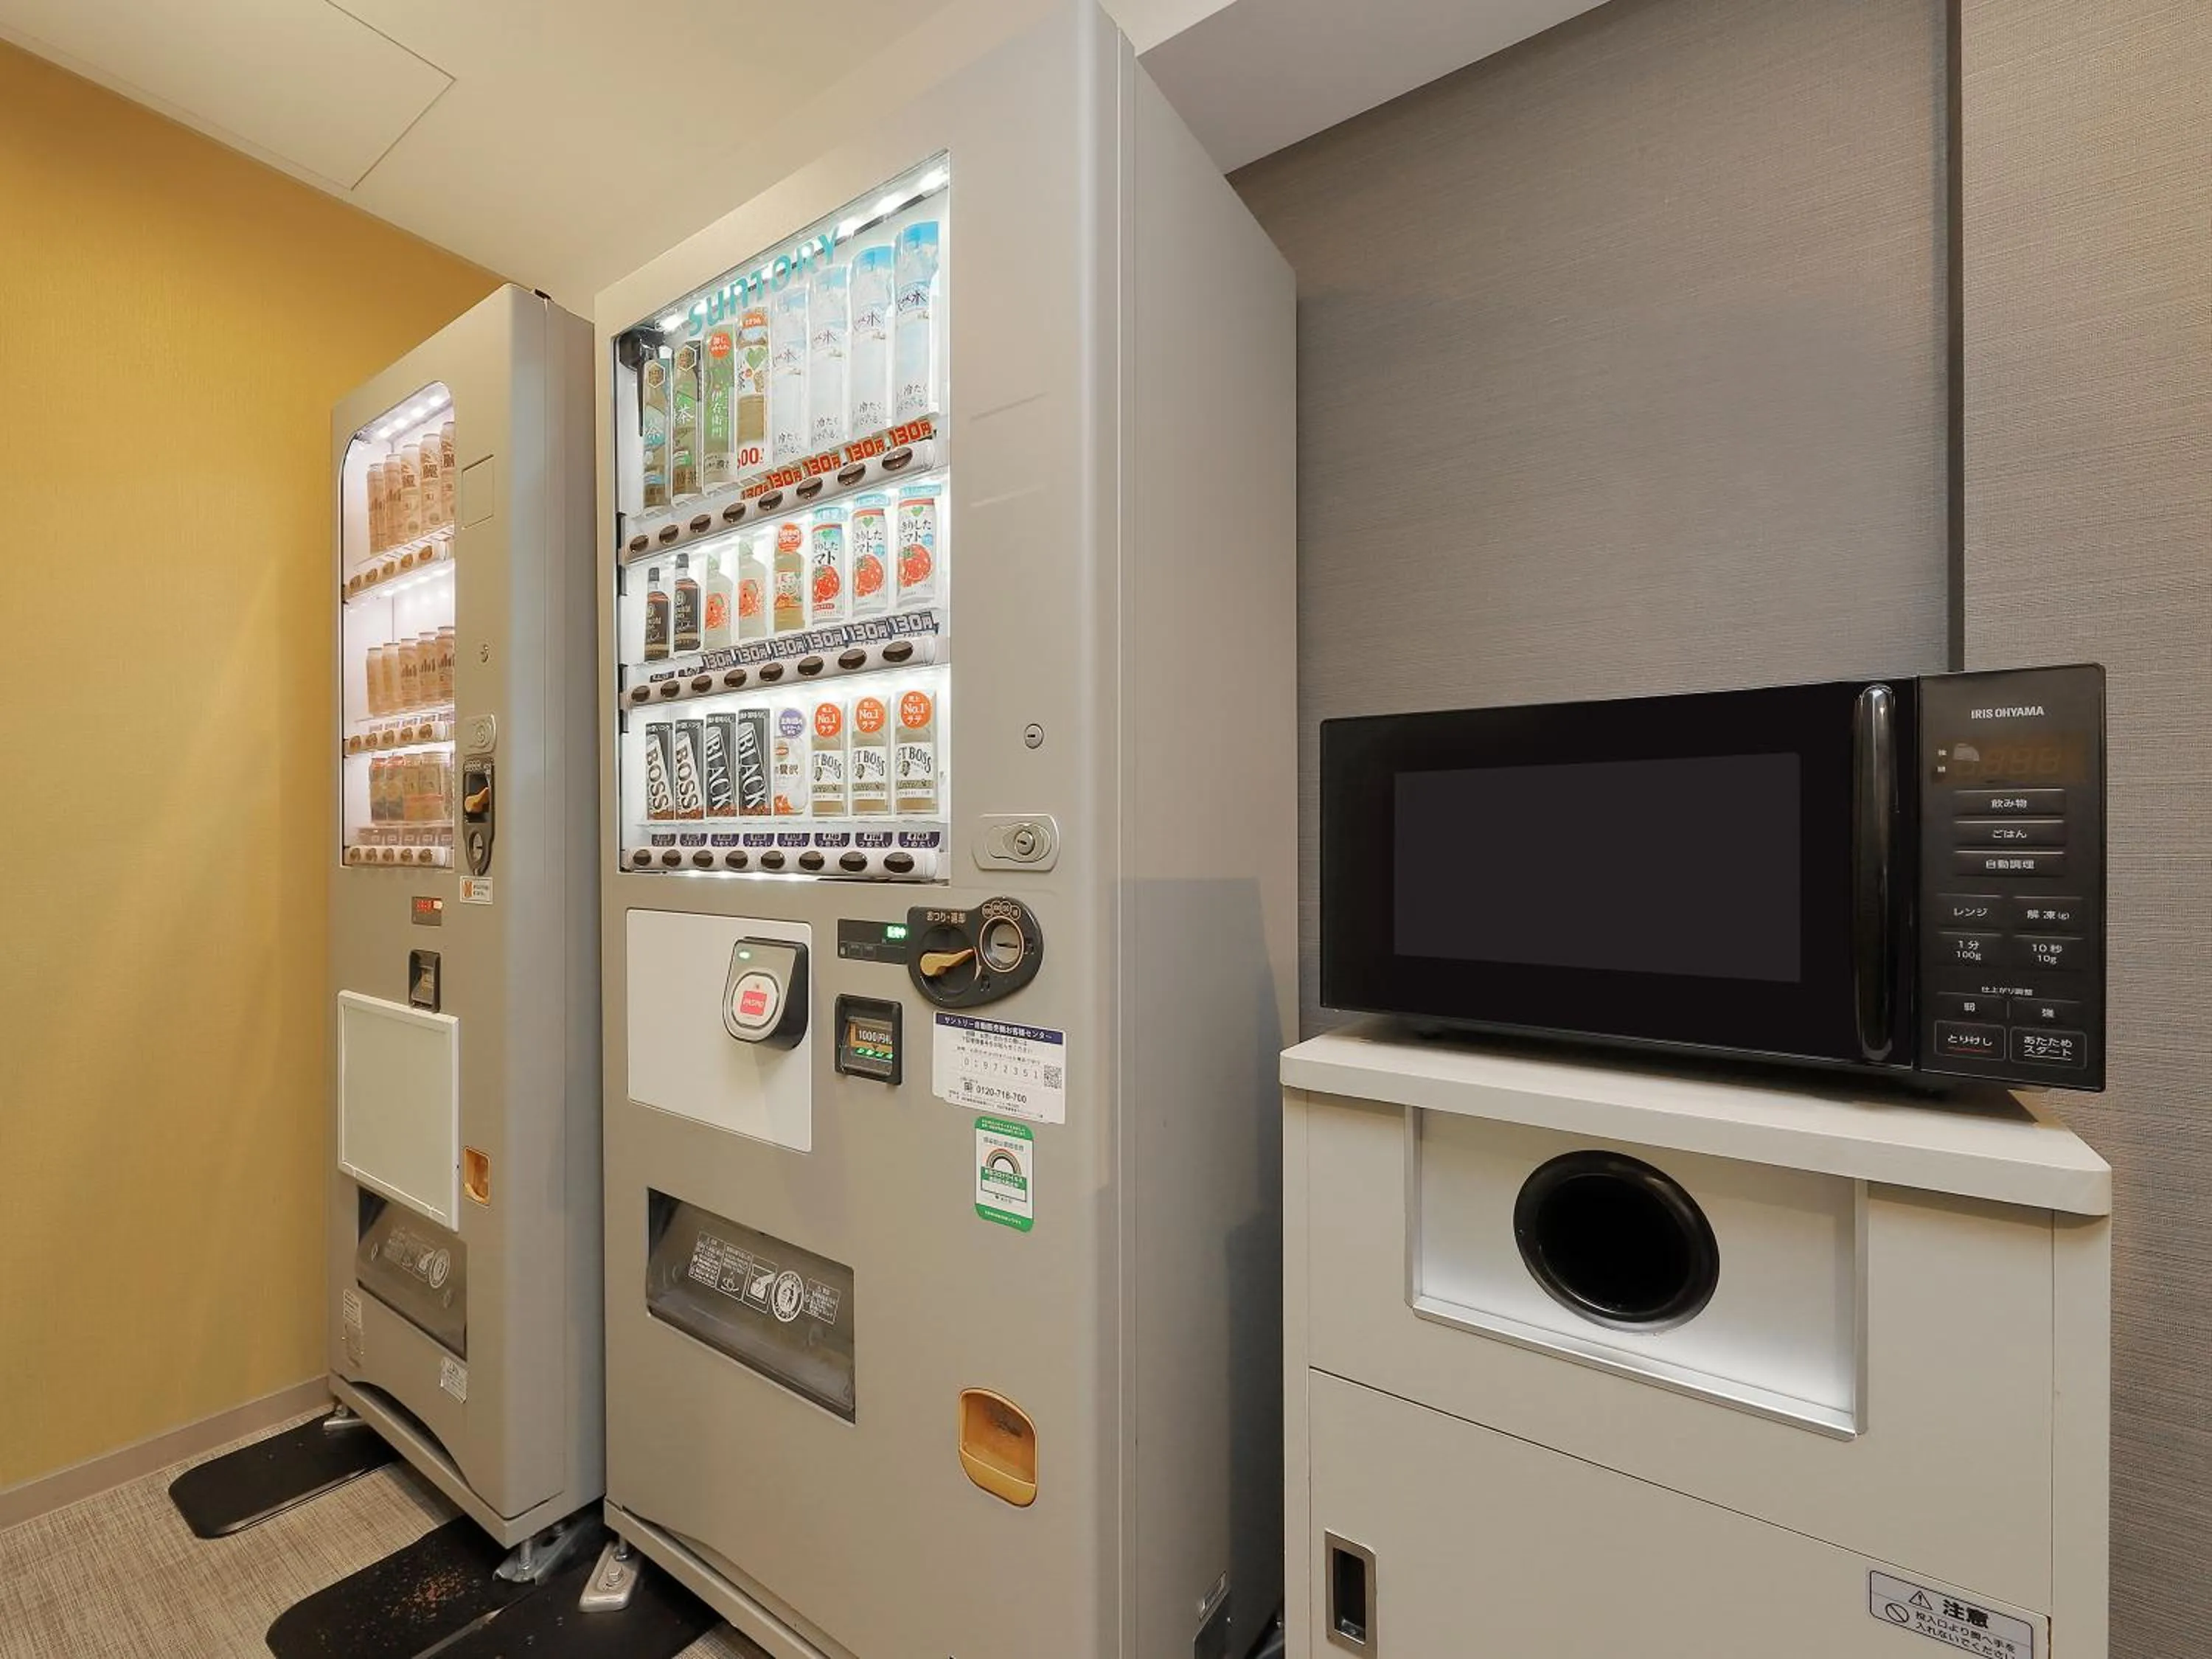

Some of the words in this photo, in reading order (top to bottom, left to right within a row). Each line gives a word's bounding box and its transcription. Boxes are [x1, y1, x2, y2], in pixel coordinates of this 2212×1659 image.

[889, 419, 932, 447] 130円
[845, 437, 886, 463] 130円
[848, 622, 887, 641] 130円
[891, 613, 933, 633] 130円
[772, 638, 804, 658] 130円
[807, 630, 844, 649] 130円
[859, 709, 880, 720] No.1
[903, 704, 927, 714] No.1
[1971, 709, 1993, 720] IRIS
[1994, 706, 2045, 718] OHYAMA
[818, 715, 837, 724] No.1
[739, 729, 767, 809] BLACK
[821, 753, 841, 779] BOSS
[863, 750, 886, 776] BOSS
[909, 746, 931, 773] BOSS
[647, 747, 669, 810] BOSS
[676, 745, 698, 810] BOSS
[707, 733, 732, 810] BLACK
[1991, 799, 2027, 809] 飲み物
[1992, 830, 2027, 838] ごはん
[1986, 859, 2035, 870] 自動調理
[1953, 908, 1988, 917] レンジ
[1955, 950, 1981, 961] 100g
[2037, 955, 2057, 964] 10g
[1947, 1034, 1992, 1047] とりけし
[2024, 1036, 2073, 1048] あたため
[2024, 1045, 2072, 1057] スタート
[1943, 1599, 1989, 1629] 注意
